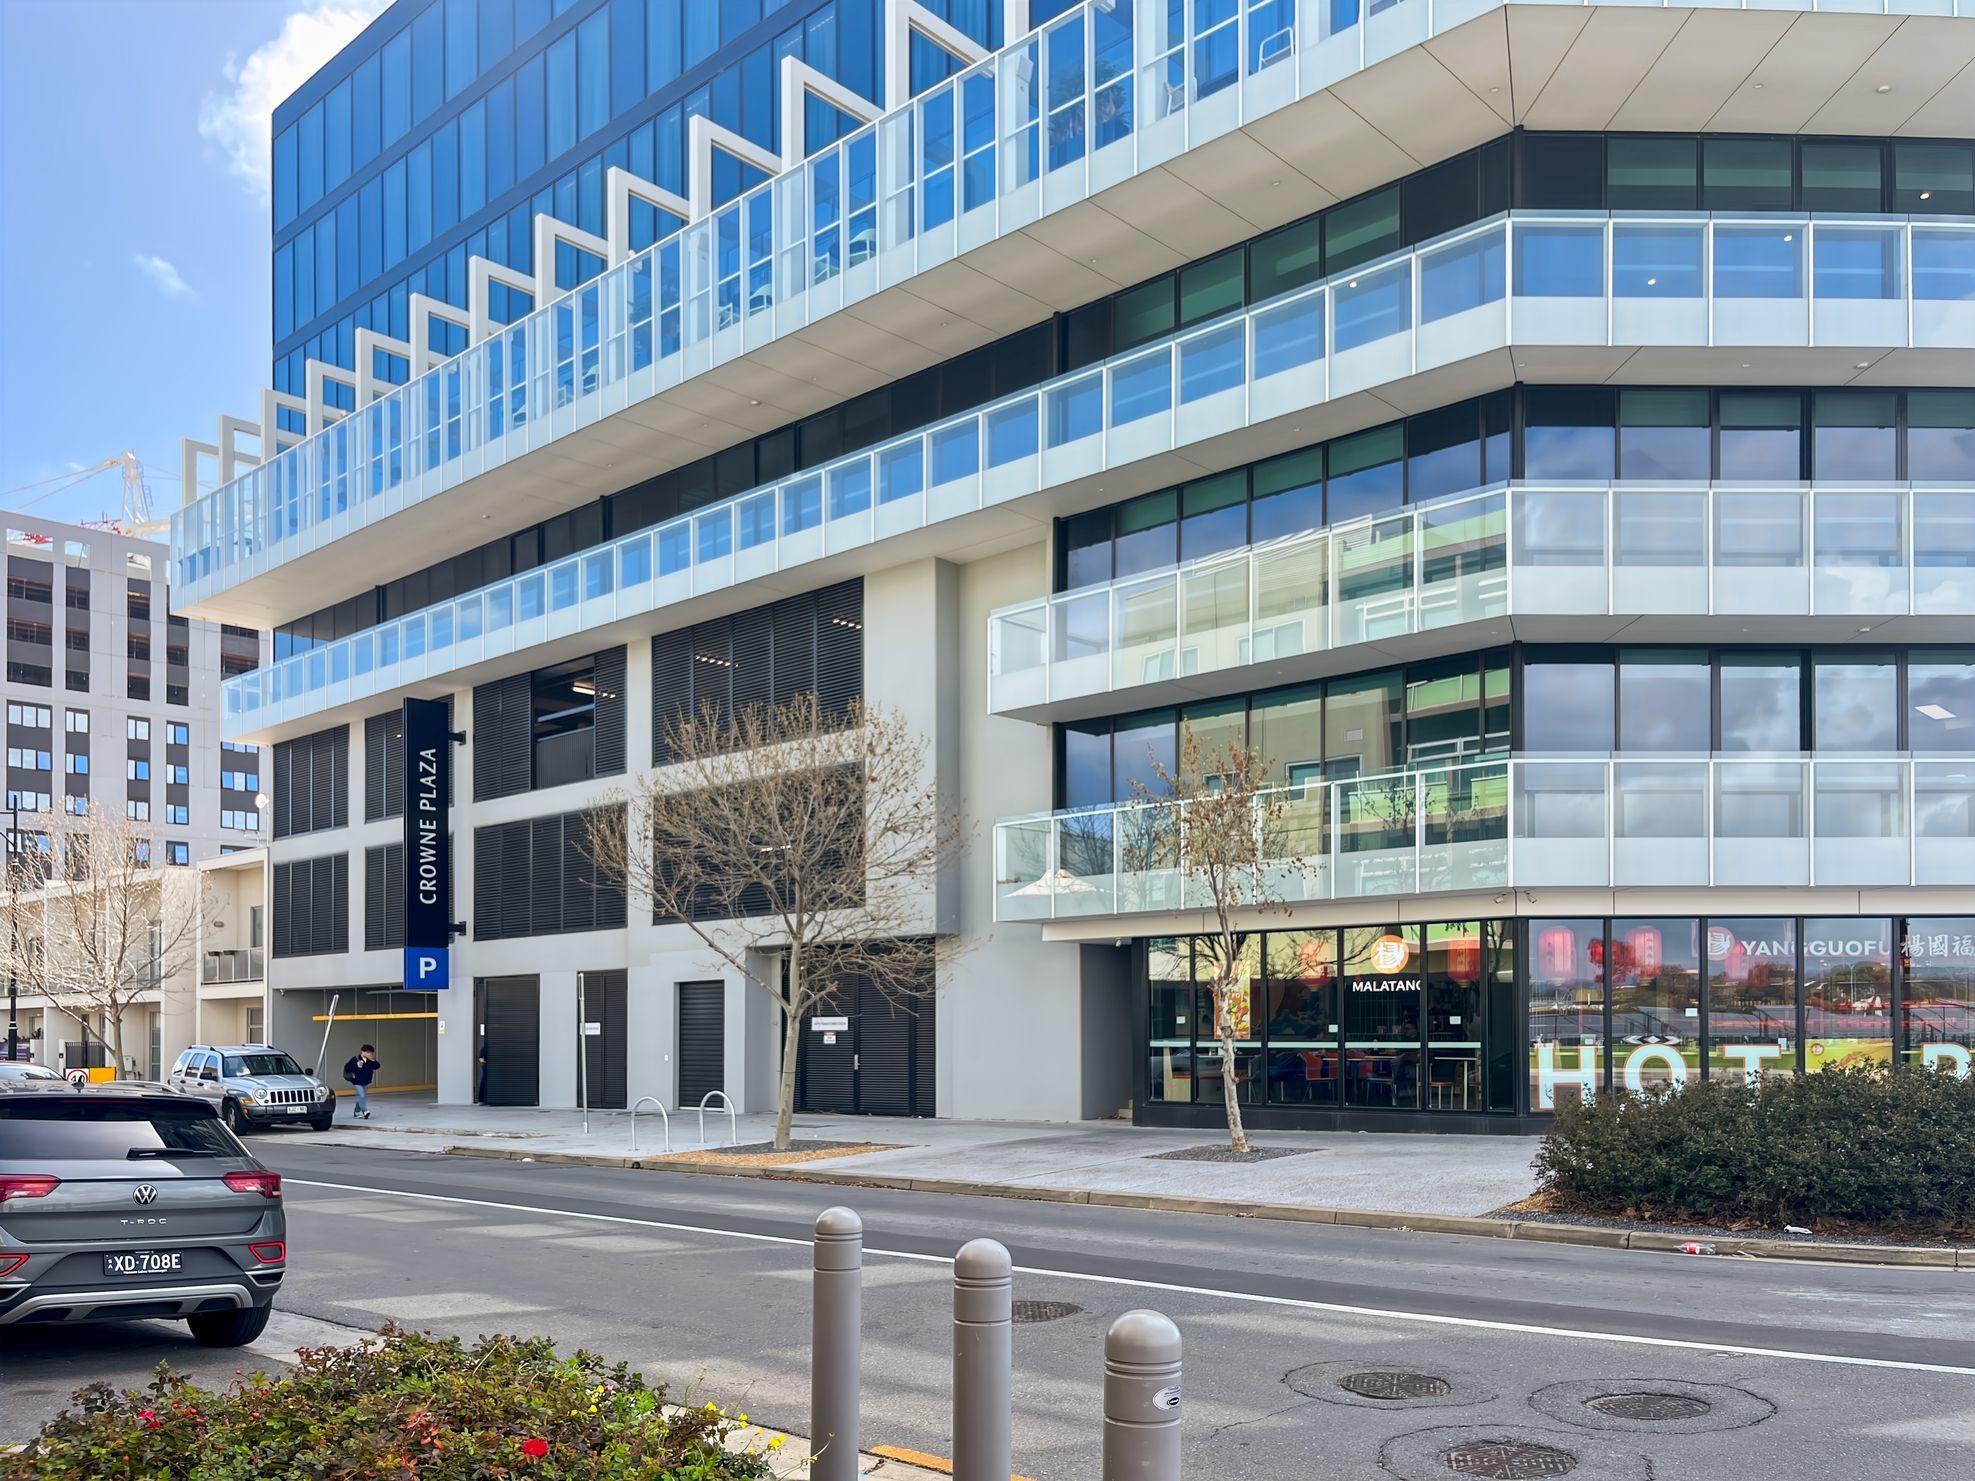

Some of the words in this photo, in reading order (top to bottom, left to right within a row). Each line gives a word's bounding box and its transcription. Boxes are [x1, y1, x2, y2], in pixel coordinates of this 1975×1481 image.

[420, 748, 437, 811] PLAZA
[420, 819, 437, 905] CROWNE
[1900, 934, 1975, 957] 楊國福
[420, 957, 437, 979] P
